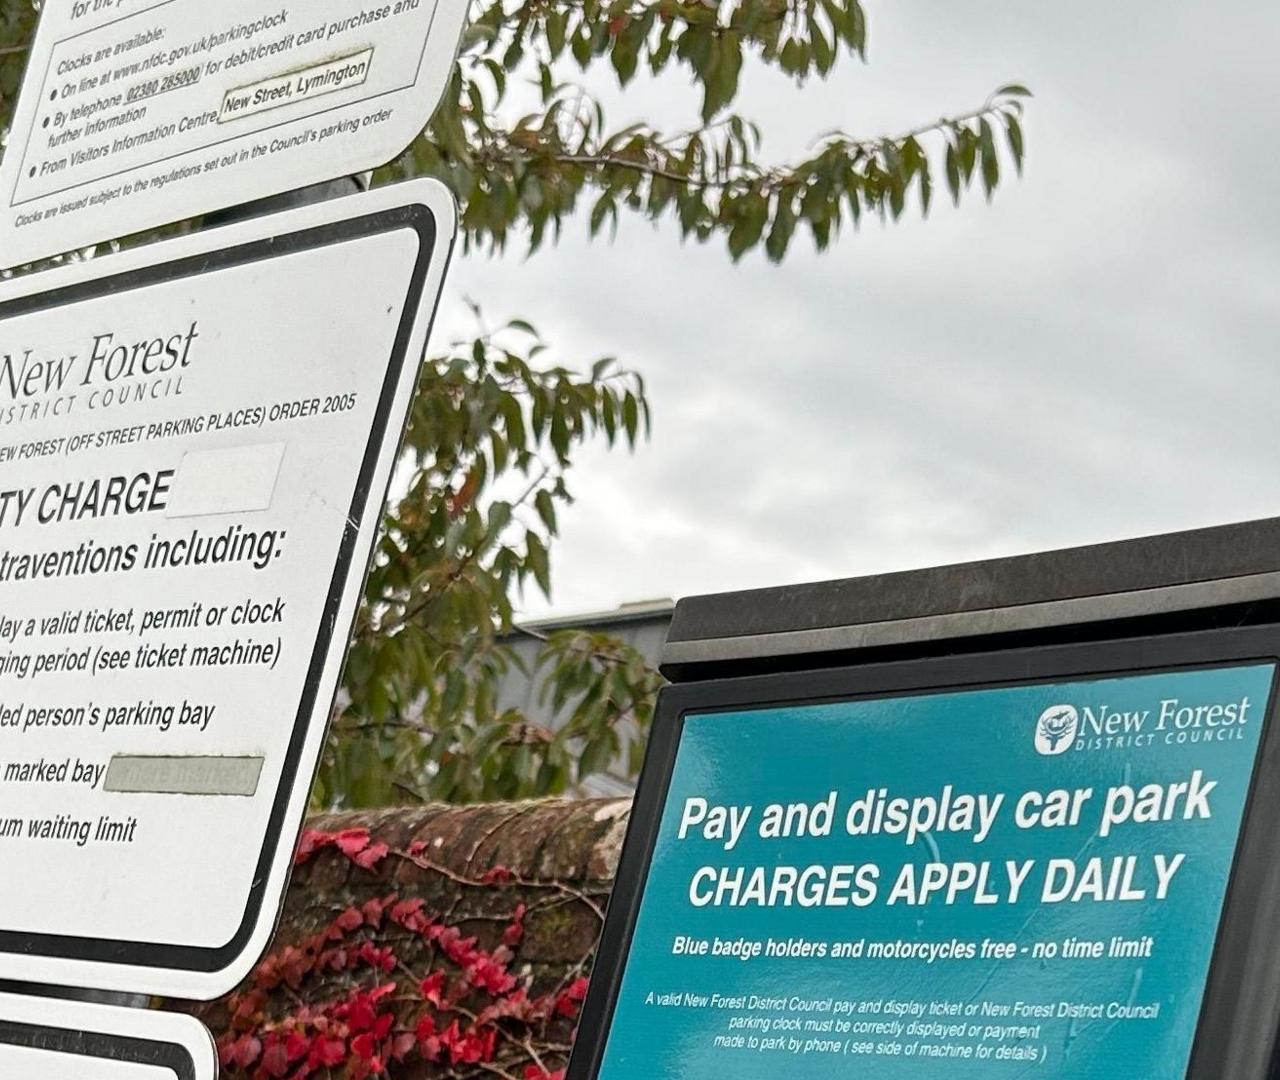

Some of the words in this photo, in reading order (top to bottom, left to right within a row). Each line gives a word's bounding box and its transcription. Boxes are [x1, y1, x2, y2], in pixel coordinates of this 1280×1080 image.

[53, 111, 68, 126] By
[69, 94, 122, 120] telephone
[126, 79, 158, 102] 02380
[159, 66, 199, 91] 285000
[204, 60, 222, 75] for
[224, 34, 294, 69] debit/credit
[296, 22, 326, 46] card
[327, 5, 391, 40] purchase
[57, 53, 92, 75] Clocks
[93, 47, 111, 62] are
[113, 27, 166, 55] available:
[61, 83, 76, 98] On
[79, 77, 98, 92] line
[99, 70, 111, 85] at
[113, 8, 288, 80] www.nfdc.gov.uk/parkingclock
[39, 158, 66, 176] From
[70, 144, 109, 166] Visitors
[111, 124, 175, 153] Information
[178, 105, 222, 132] Centre,
[224, 95, 251, 113] New
[252, 81, 292, 104] Street,
[296, 62, 365, 94] Lymington
[79, 321, 198, 385] Forest
[88, 376, 182, 409] COUNCIL
[38, 469, 174, 523] CHARGE
[144, 524, 285, 569] including:
[22, 702, 100, 732] person's
[102, 700, 174, 732] parking
[178, 700, 215, 731] bay
[1075, 734, 1154, 750] DISTRICT
[1165, 728, 1242, 744] COUNCIL
[1077, 705, 1149, 736] New
[1155, 697, 1250, 730] Forest
[678, 798, 751, 850] Pay
[759, 791, 837, 837] and
[846, 785, 1004, 845] display
[1015, 788, 1092, 828] car
[1099, 770, 1216, 836] park
[689, 864, 879, 906] CHARGES
[887, 860, 1034, 904] APPLY
[1041, 854, 1185, 901] DAILY
[672, 937, 708, 954] Blue
[712, 937, 761, 960] badge
[765, 938, 827, 956] holders
[831, 939, 864, 957] and
[867, 938, 976, 962] motorcycles
[981, 939, 1016, 958] free
[1032, 943, 1057, 958] no
[1062, 937, 1104, 957] time
[1108, 936, 1153, 956] limit
